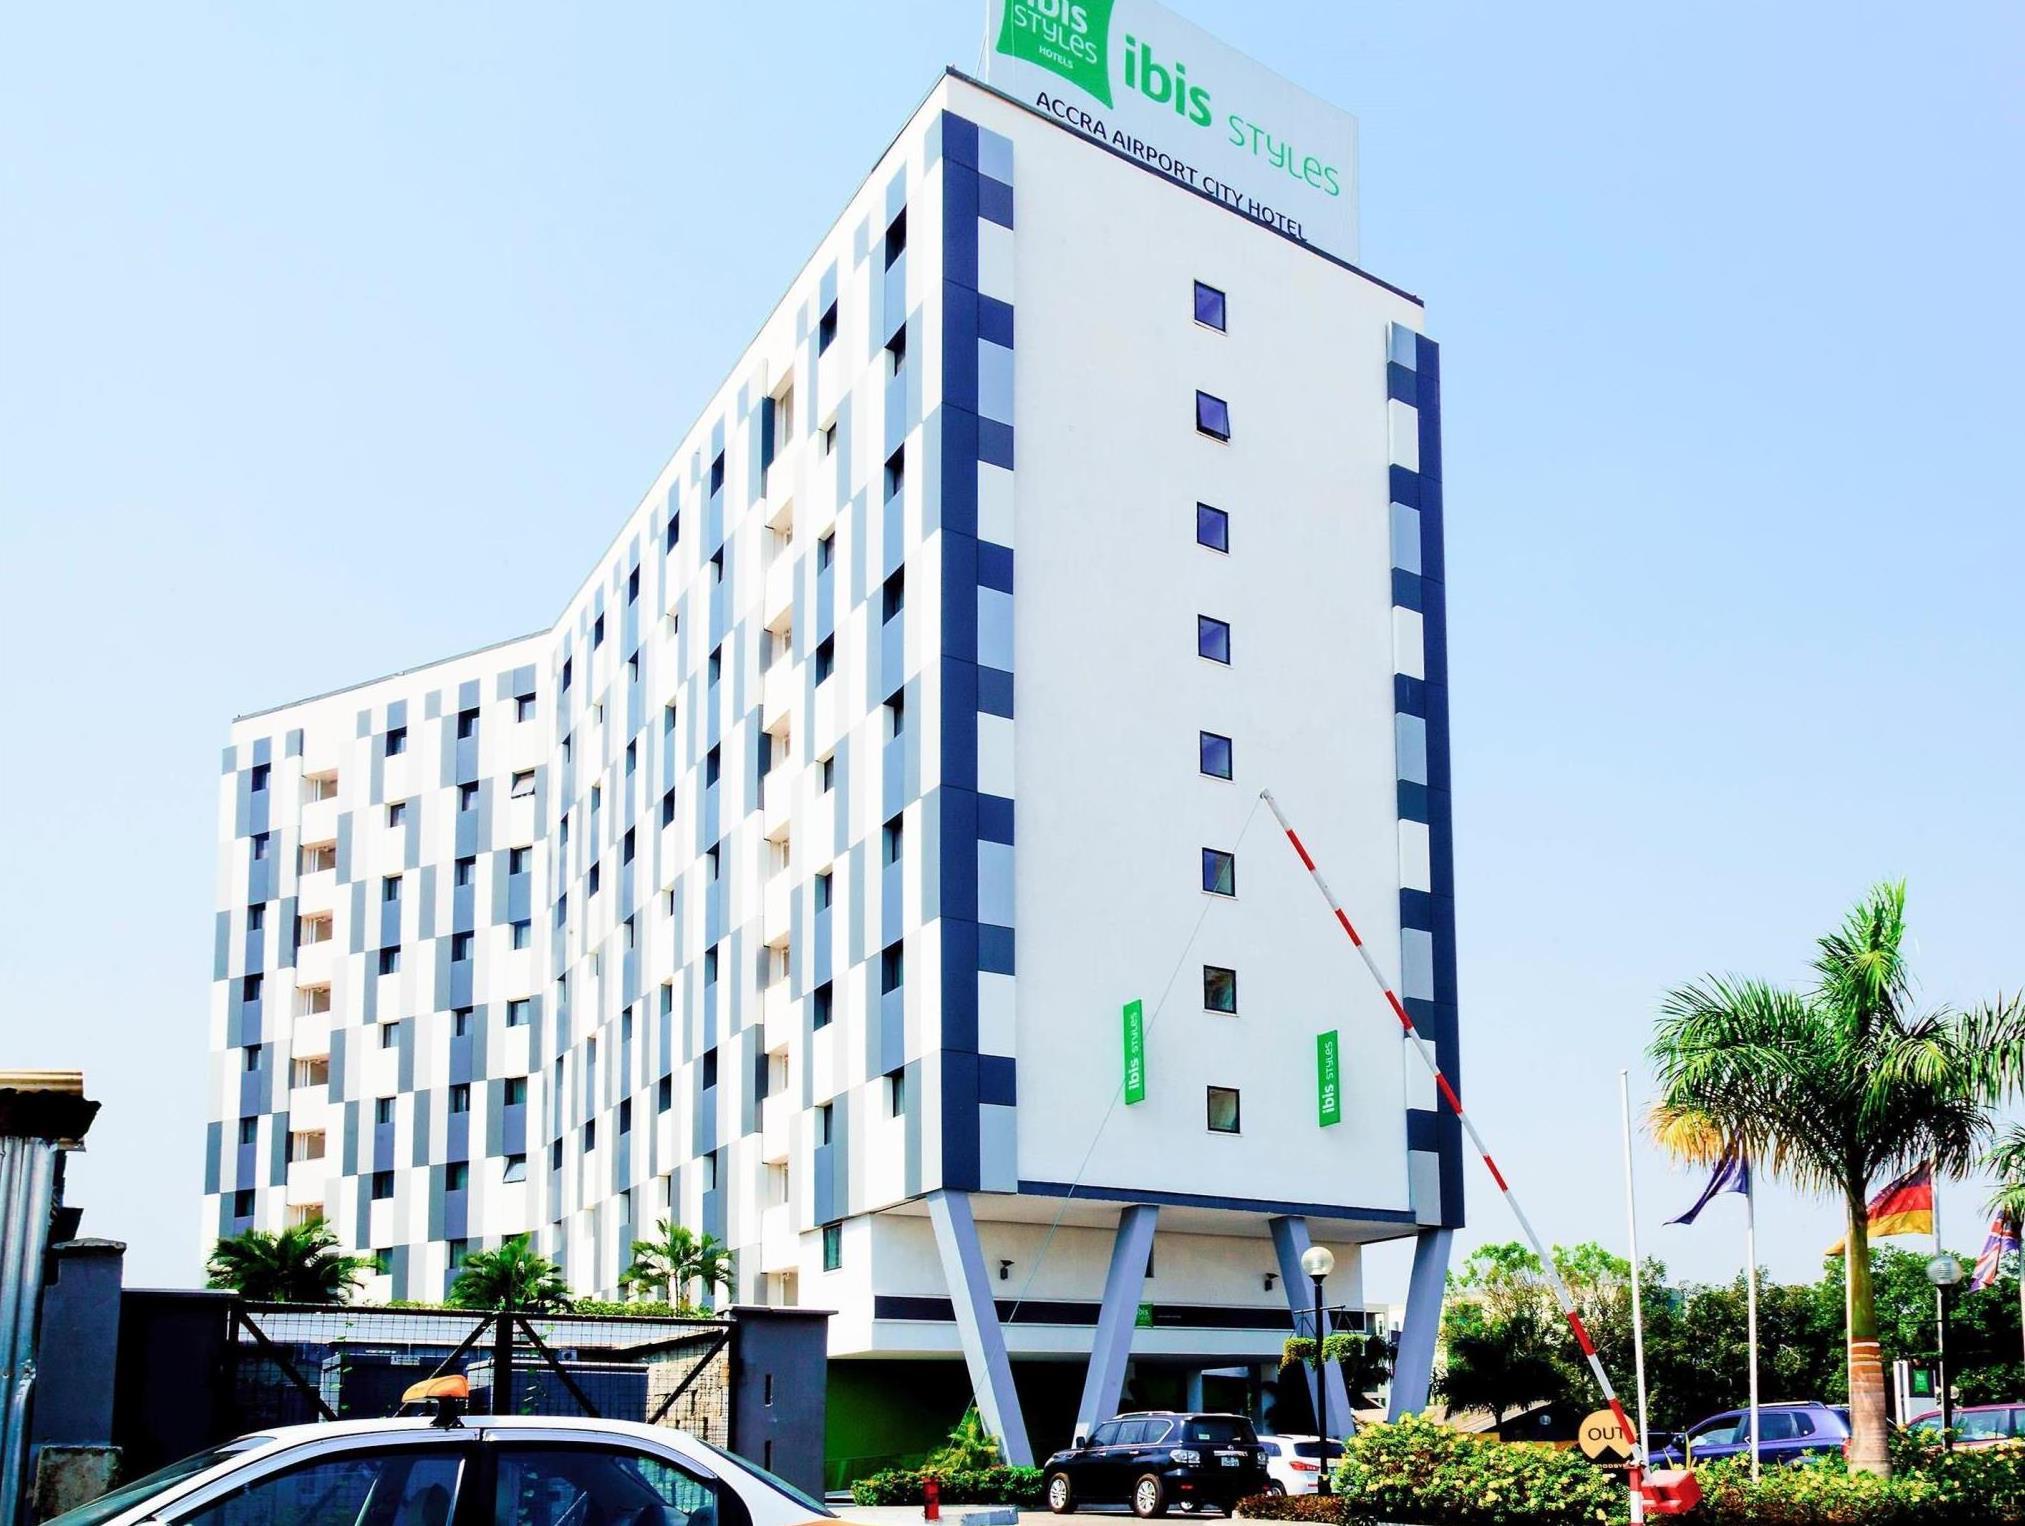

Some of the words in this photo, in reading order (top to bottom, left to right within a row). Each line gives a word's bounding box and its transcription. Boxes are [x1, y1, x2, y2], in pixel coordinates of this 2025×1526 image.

[1039, 45, 1074, 69] HOTELS
[1123, 33, 1213, 128] ibis
[1036, 91, 1107, 140] ACCRA
[1112, 130, 1198, 184] AIRPORT
[1203, 176, 1244, 209] CITY
[1248, 198, 1307, 242] HOTEL
[1128, 1057, 1140, 1090] ibis
[1322, 1083, 1335, 1114] ibis
[1588, 1427, 1623, 1441] OUT
